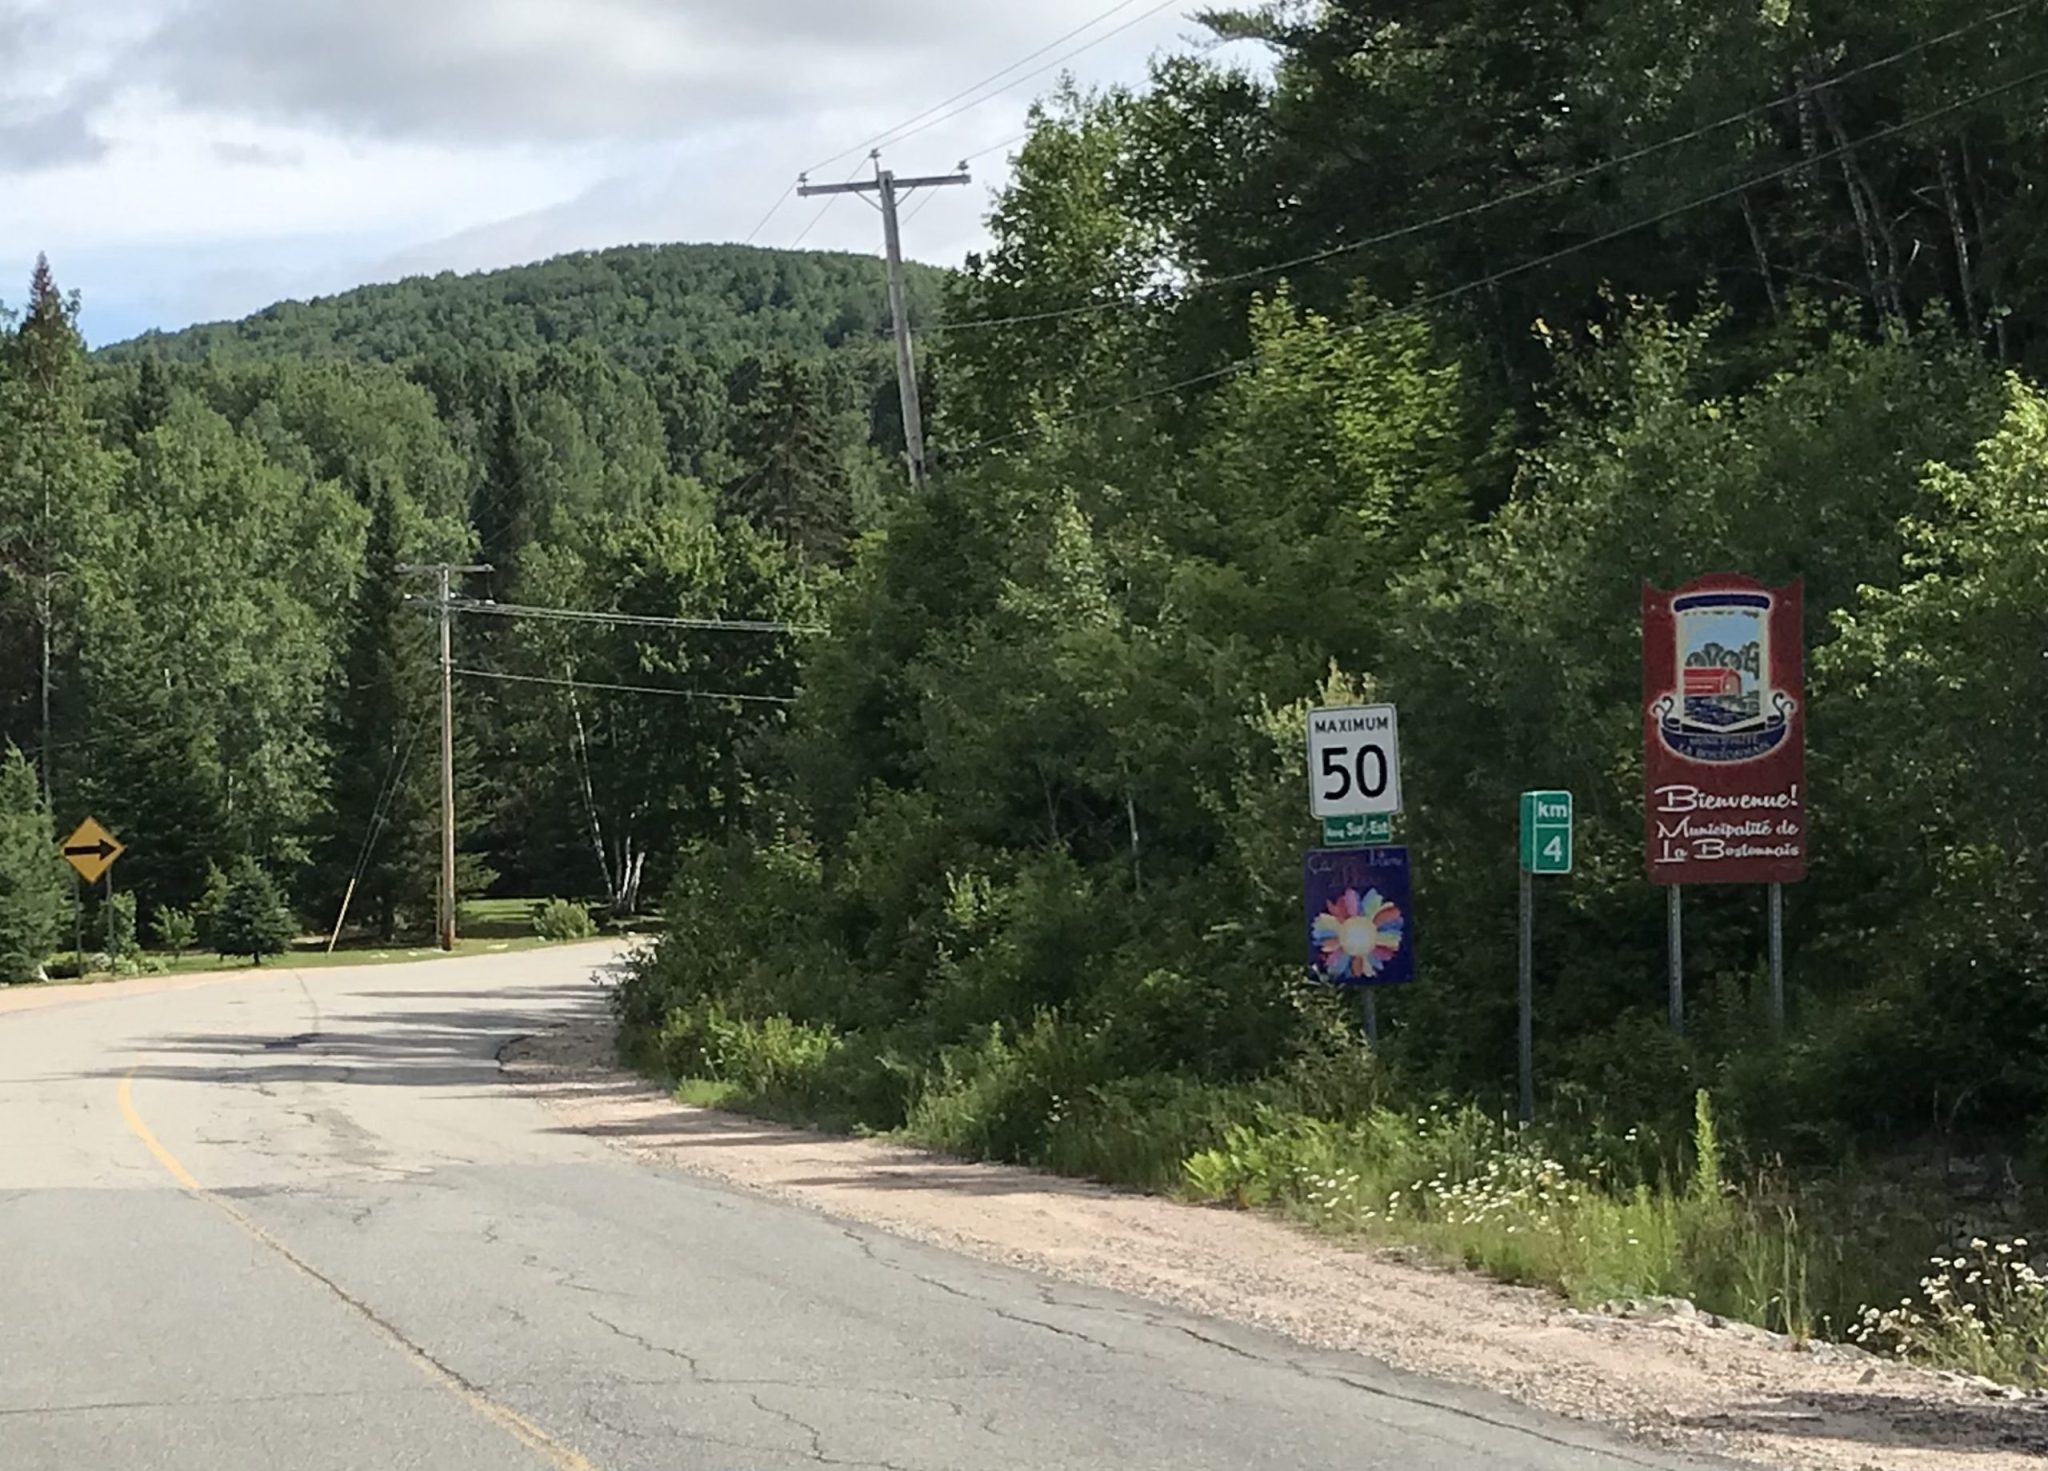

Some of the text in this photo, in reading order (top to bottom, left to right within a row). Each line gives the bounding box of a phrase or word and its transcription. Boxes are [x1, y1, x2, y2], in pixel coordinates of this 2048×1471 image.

[1315, 716, 1389, 733] MAXIMUM
[1322, 744, 1388, 800] 50
[1538, 801, 1568, 817] km
[1654, 784, 1799, 812] Bienvenue!
[1656, 816, 1799, 838] Municipalité de
[1543, 835, 1562, 863] 4
[1654, 840, 1688, 863] La
